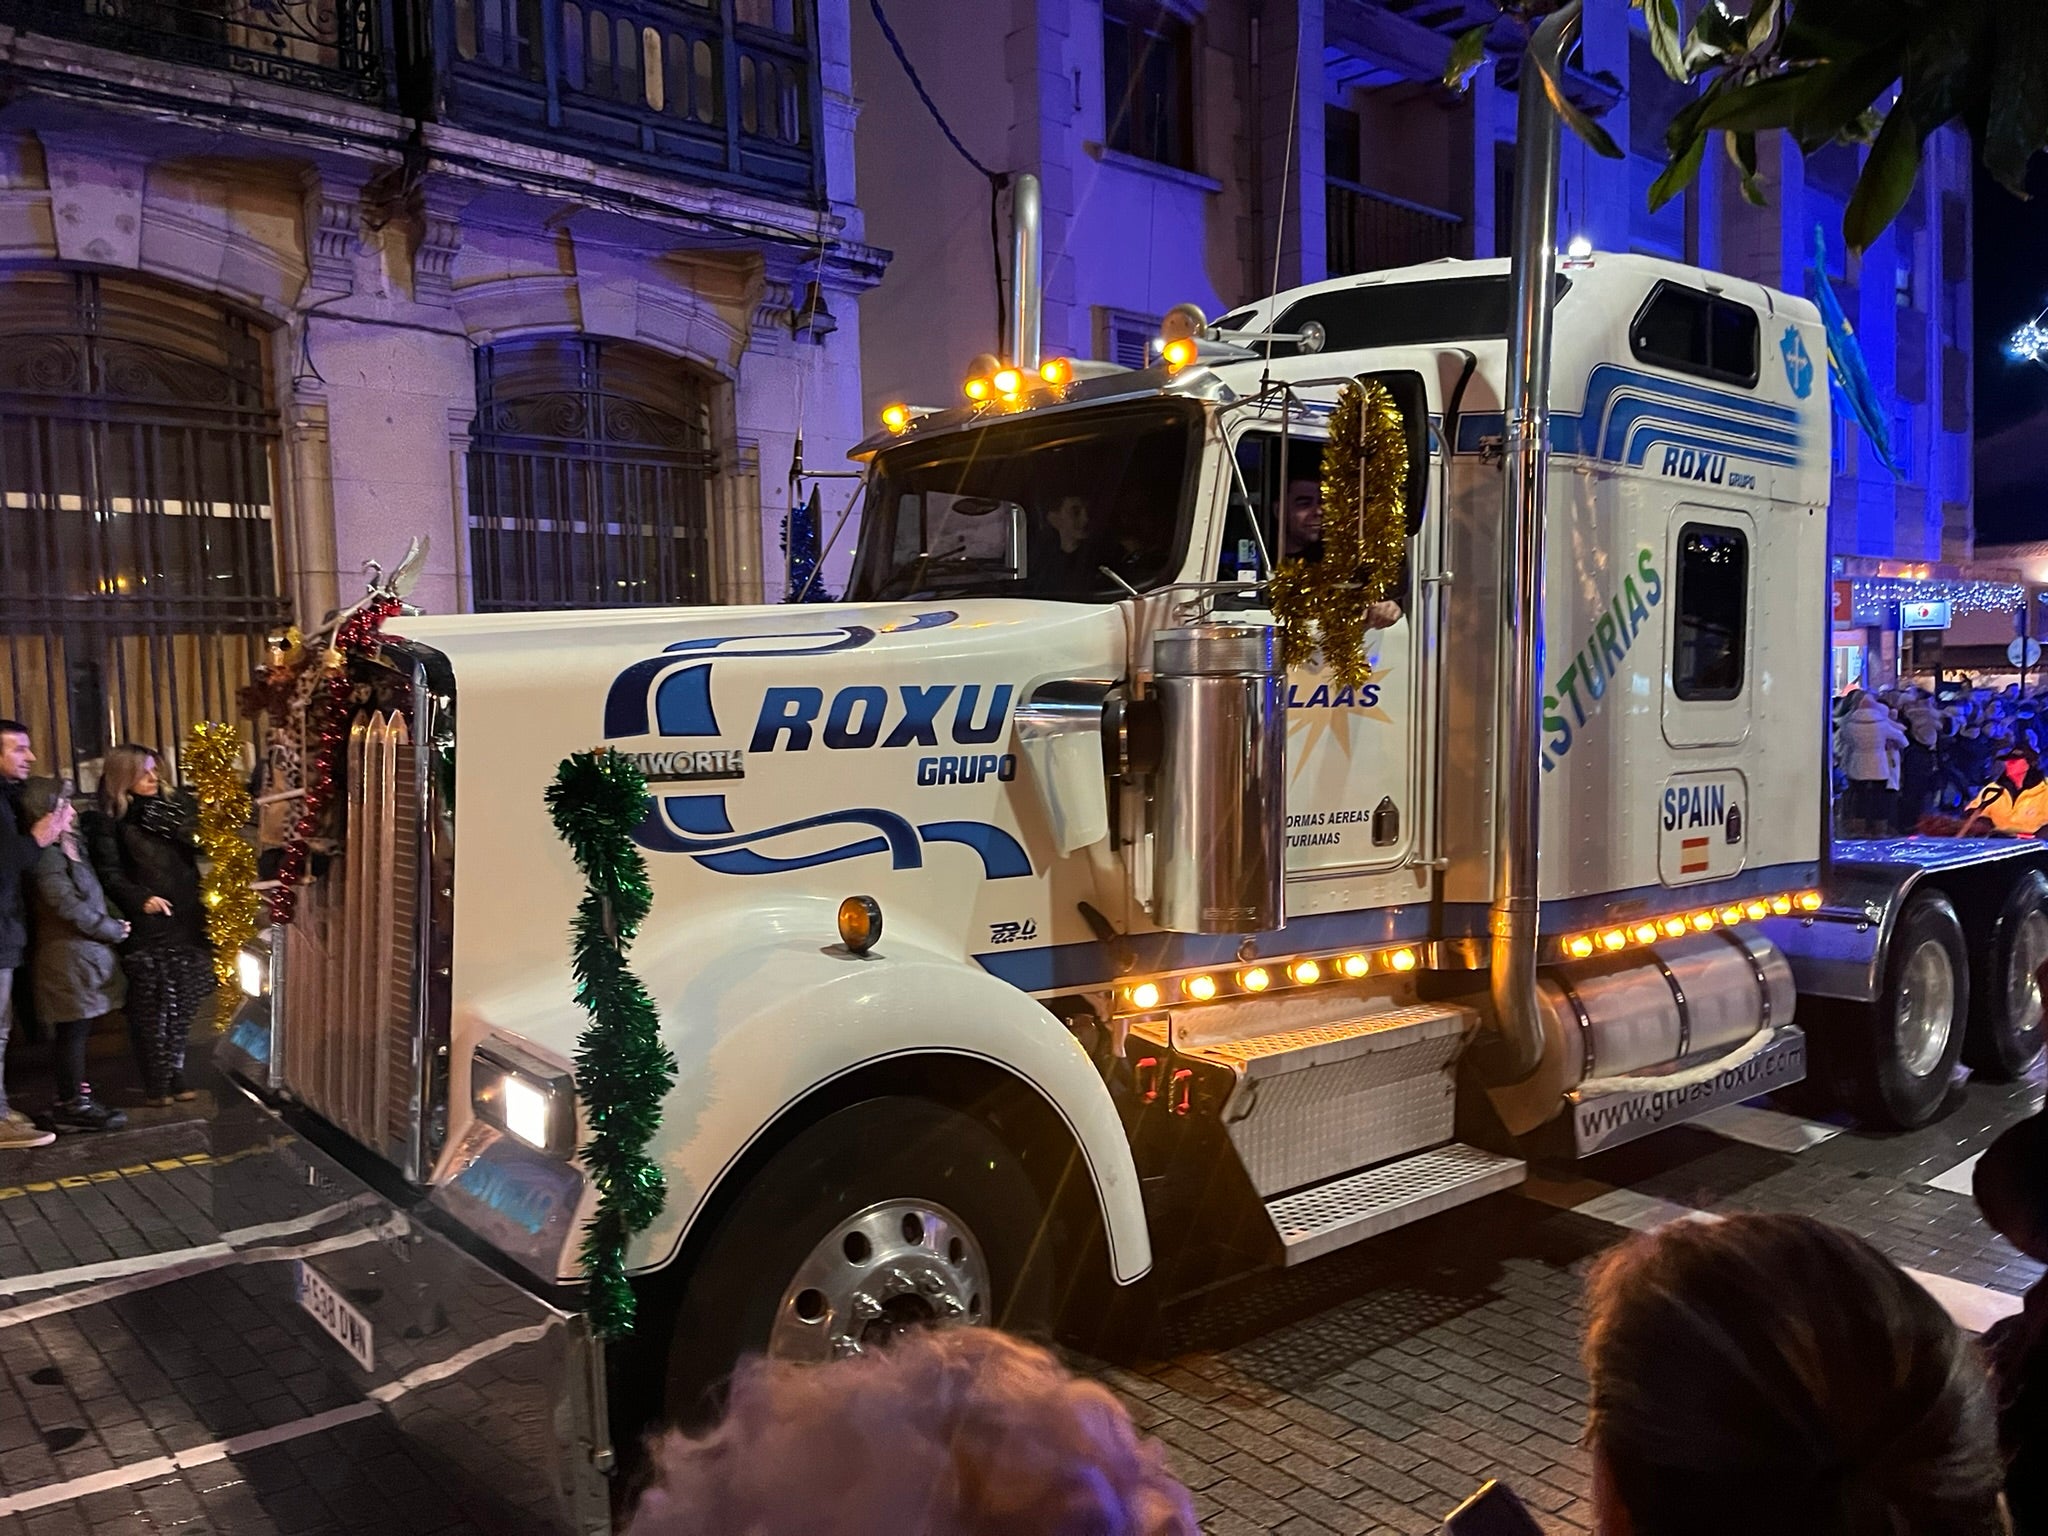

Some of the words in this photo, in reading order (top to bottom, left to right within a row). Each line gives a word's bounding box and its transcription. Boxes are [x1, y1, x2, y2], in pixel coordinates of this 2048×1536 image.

[1662, 446, 1727, 484] ROXU
[1729, 472, 1756, 490] GRUPO
[1287, 683, 1381, 709] LAAS
[749, 684, 1014, 753] ROXU
[917, 753, 1017, 787] GRUPO
[1327, 810, 1371, 825] AEREAS
[1663, 784, 1725, 831] SPAIN
